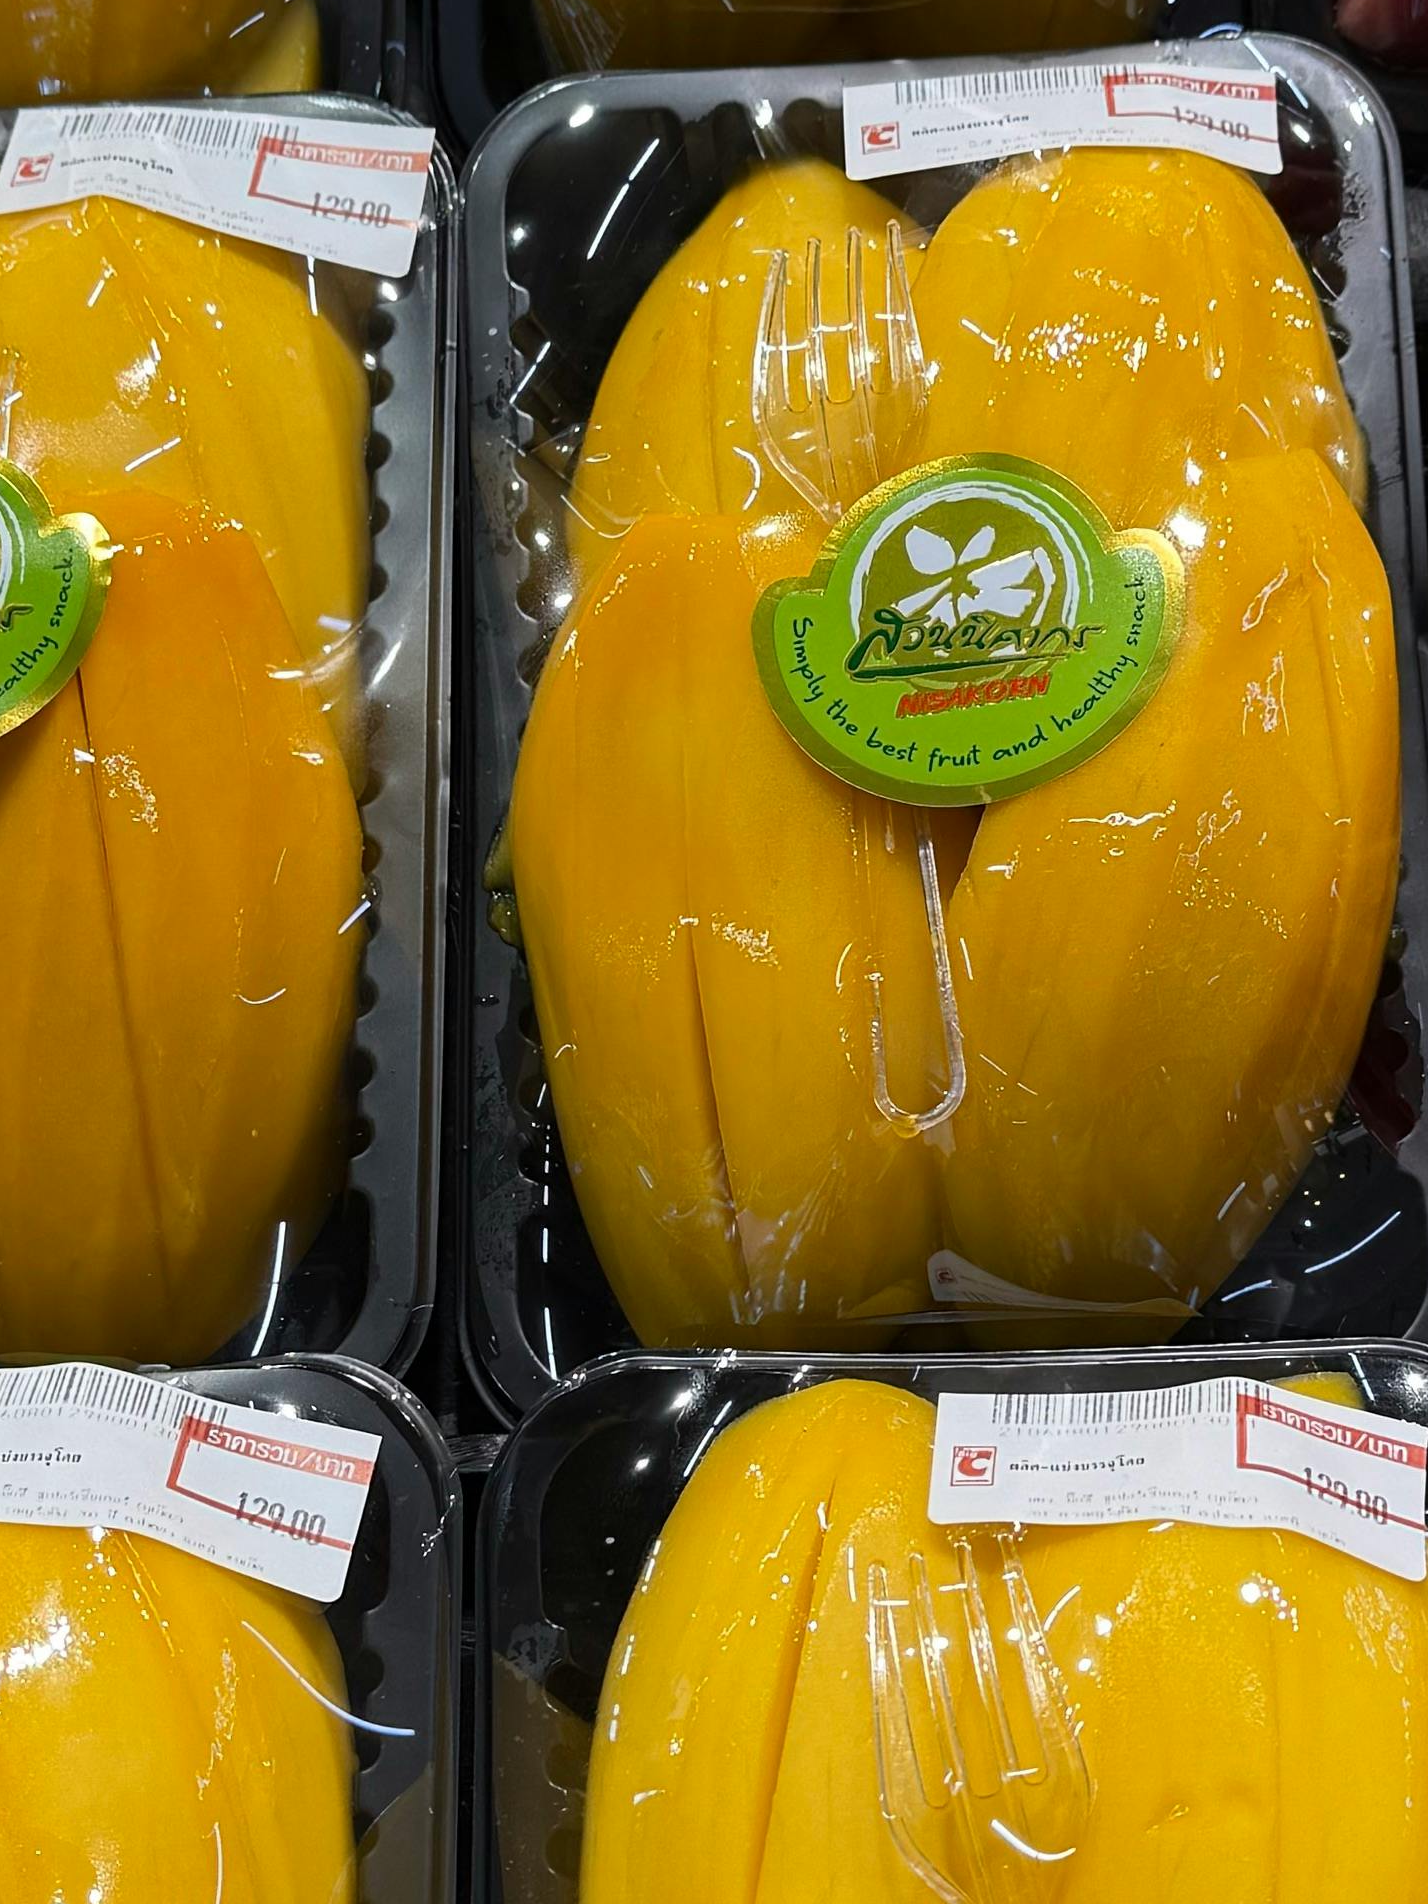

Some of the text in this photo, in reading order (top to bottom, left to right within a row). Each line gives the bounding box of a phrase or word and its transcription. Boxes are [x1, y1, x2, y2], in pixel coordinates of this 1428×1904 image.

[1171, 105, 1250, 141] 129.00
[283, 143, 414, 172] ราคารวม/บาท
[311, 191, 392, 230] 129.00
[47, 546, 74, 626] snack.
[790, 617, 1138, 771] Simply the best fruit and healthy
[894, 672, 1050, 719] NISAKORN
[207, 1426, 356, 1480] ราคารวม/บาท
[1262, 1402, 1409, 1464] ราคารวม/บาท
[236, 1491, 327, 1546] 129.00
[1303, 1467, 1389, 1526] 129.00
